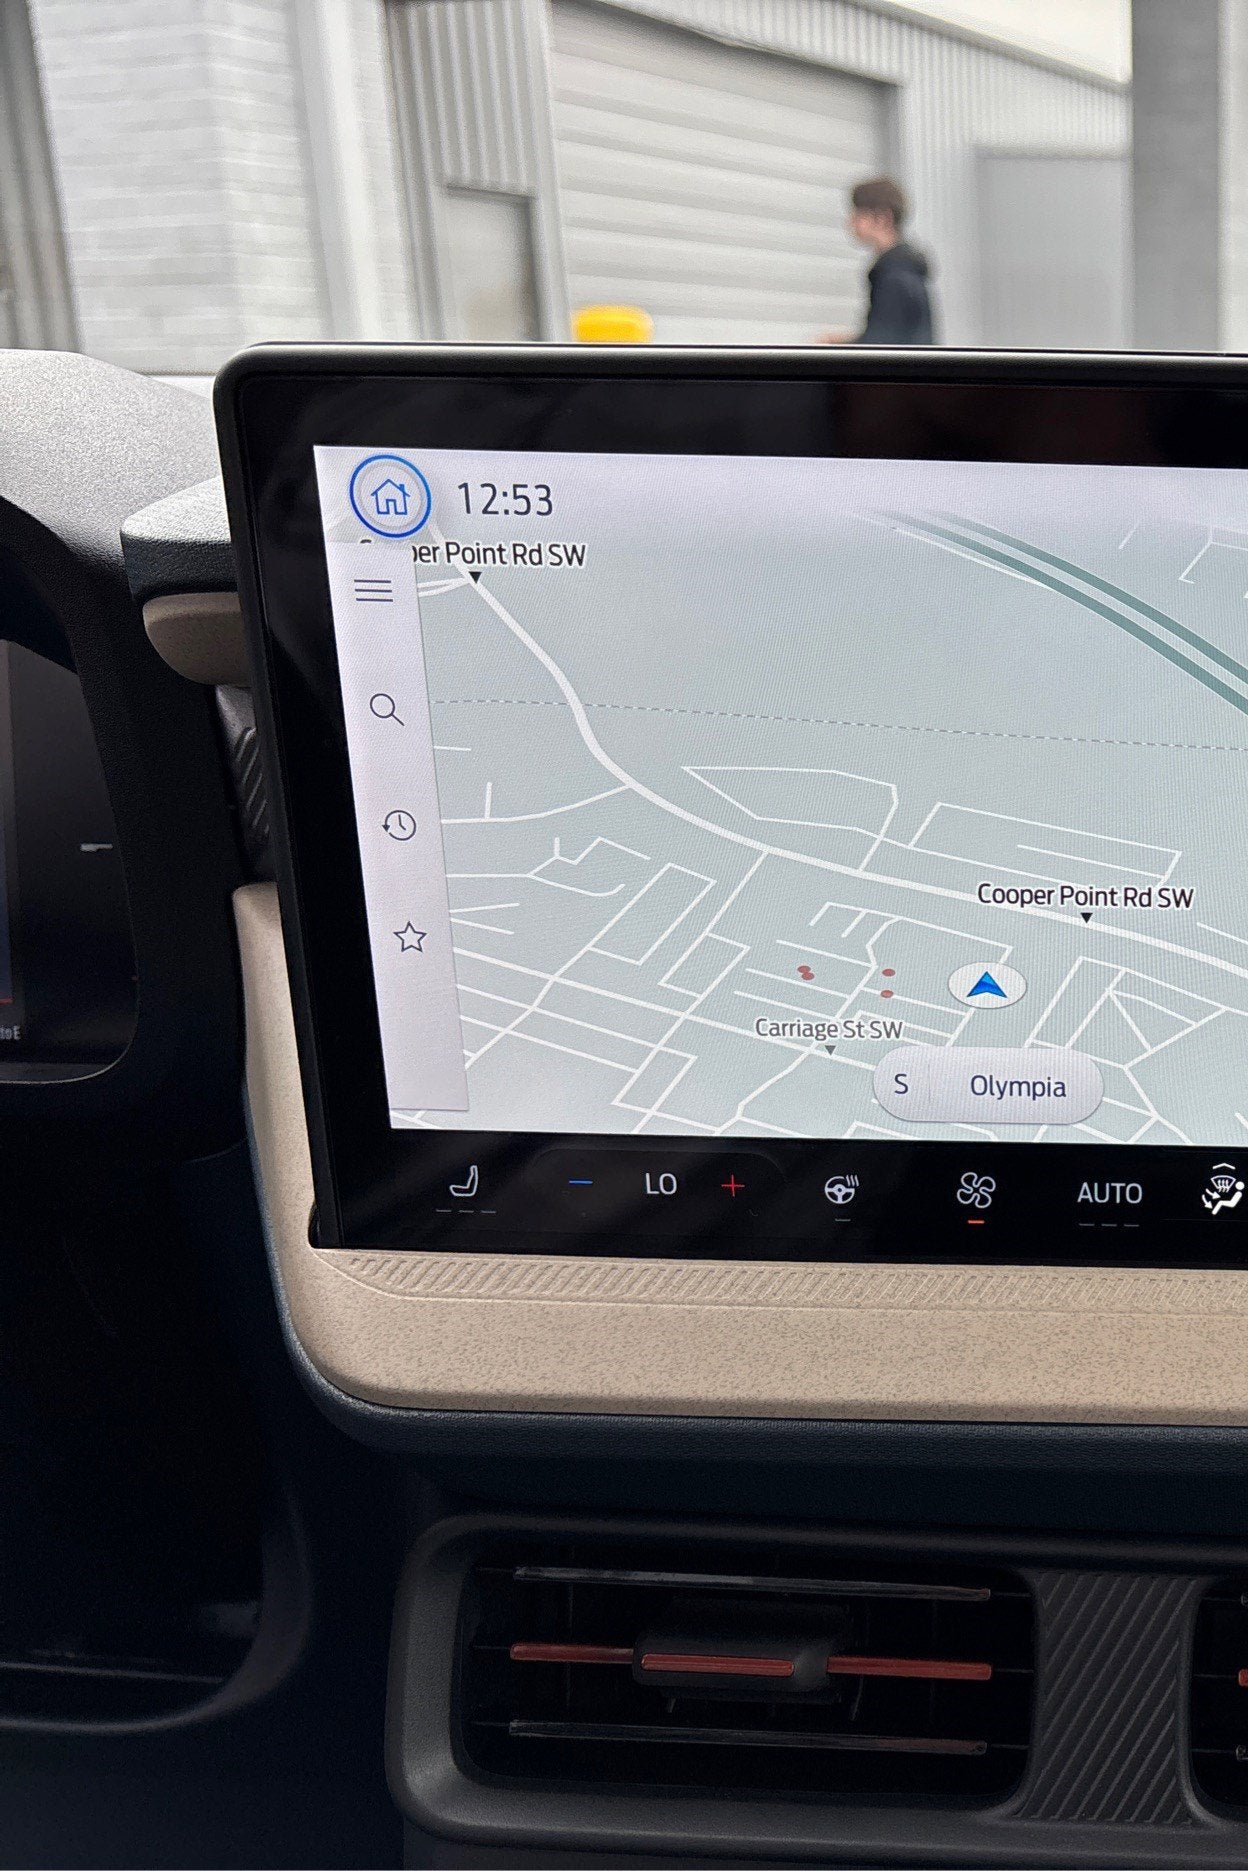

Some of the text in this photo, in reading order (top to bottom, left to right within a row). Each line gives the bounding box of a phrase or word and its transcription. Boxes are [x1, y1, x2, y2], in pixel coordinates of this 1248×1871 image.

[457, 482, 554, 516] 12:53
[446, 540, 506, 565] Point
[513, 543, 543, 566] Rd
[548, 544, 586, 567] SW
[977, 883, 1194, 909] Cooper Point Rd SW
[755, 1018, 903, 1040] Carriage St SW
[894, 1074, 909, 1096] S
[970, 1075, 1066, 1100] Olympia
[645, 1173, 677, 1195] LO
[1077, 1182, 1143, 1204] AUTO
